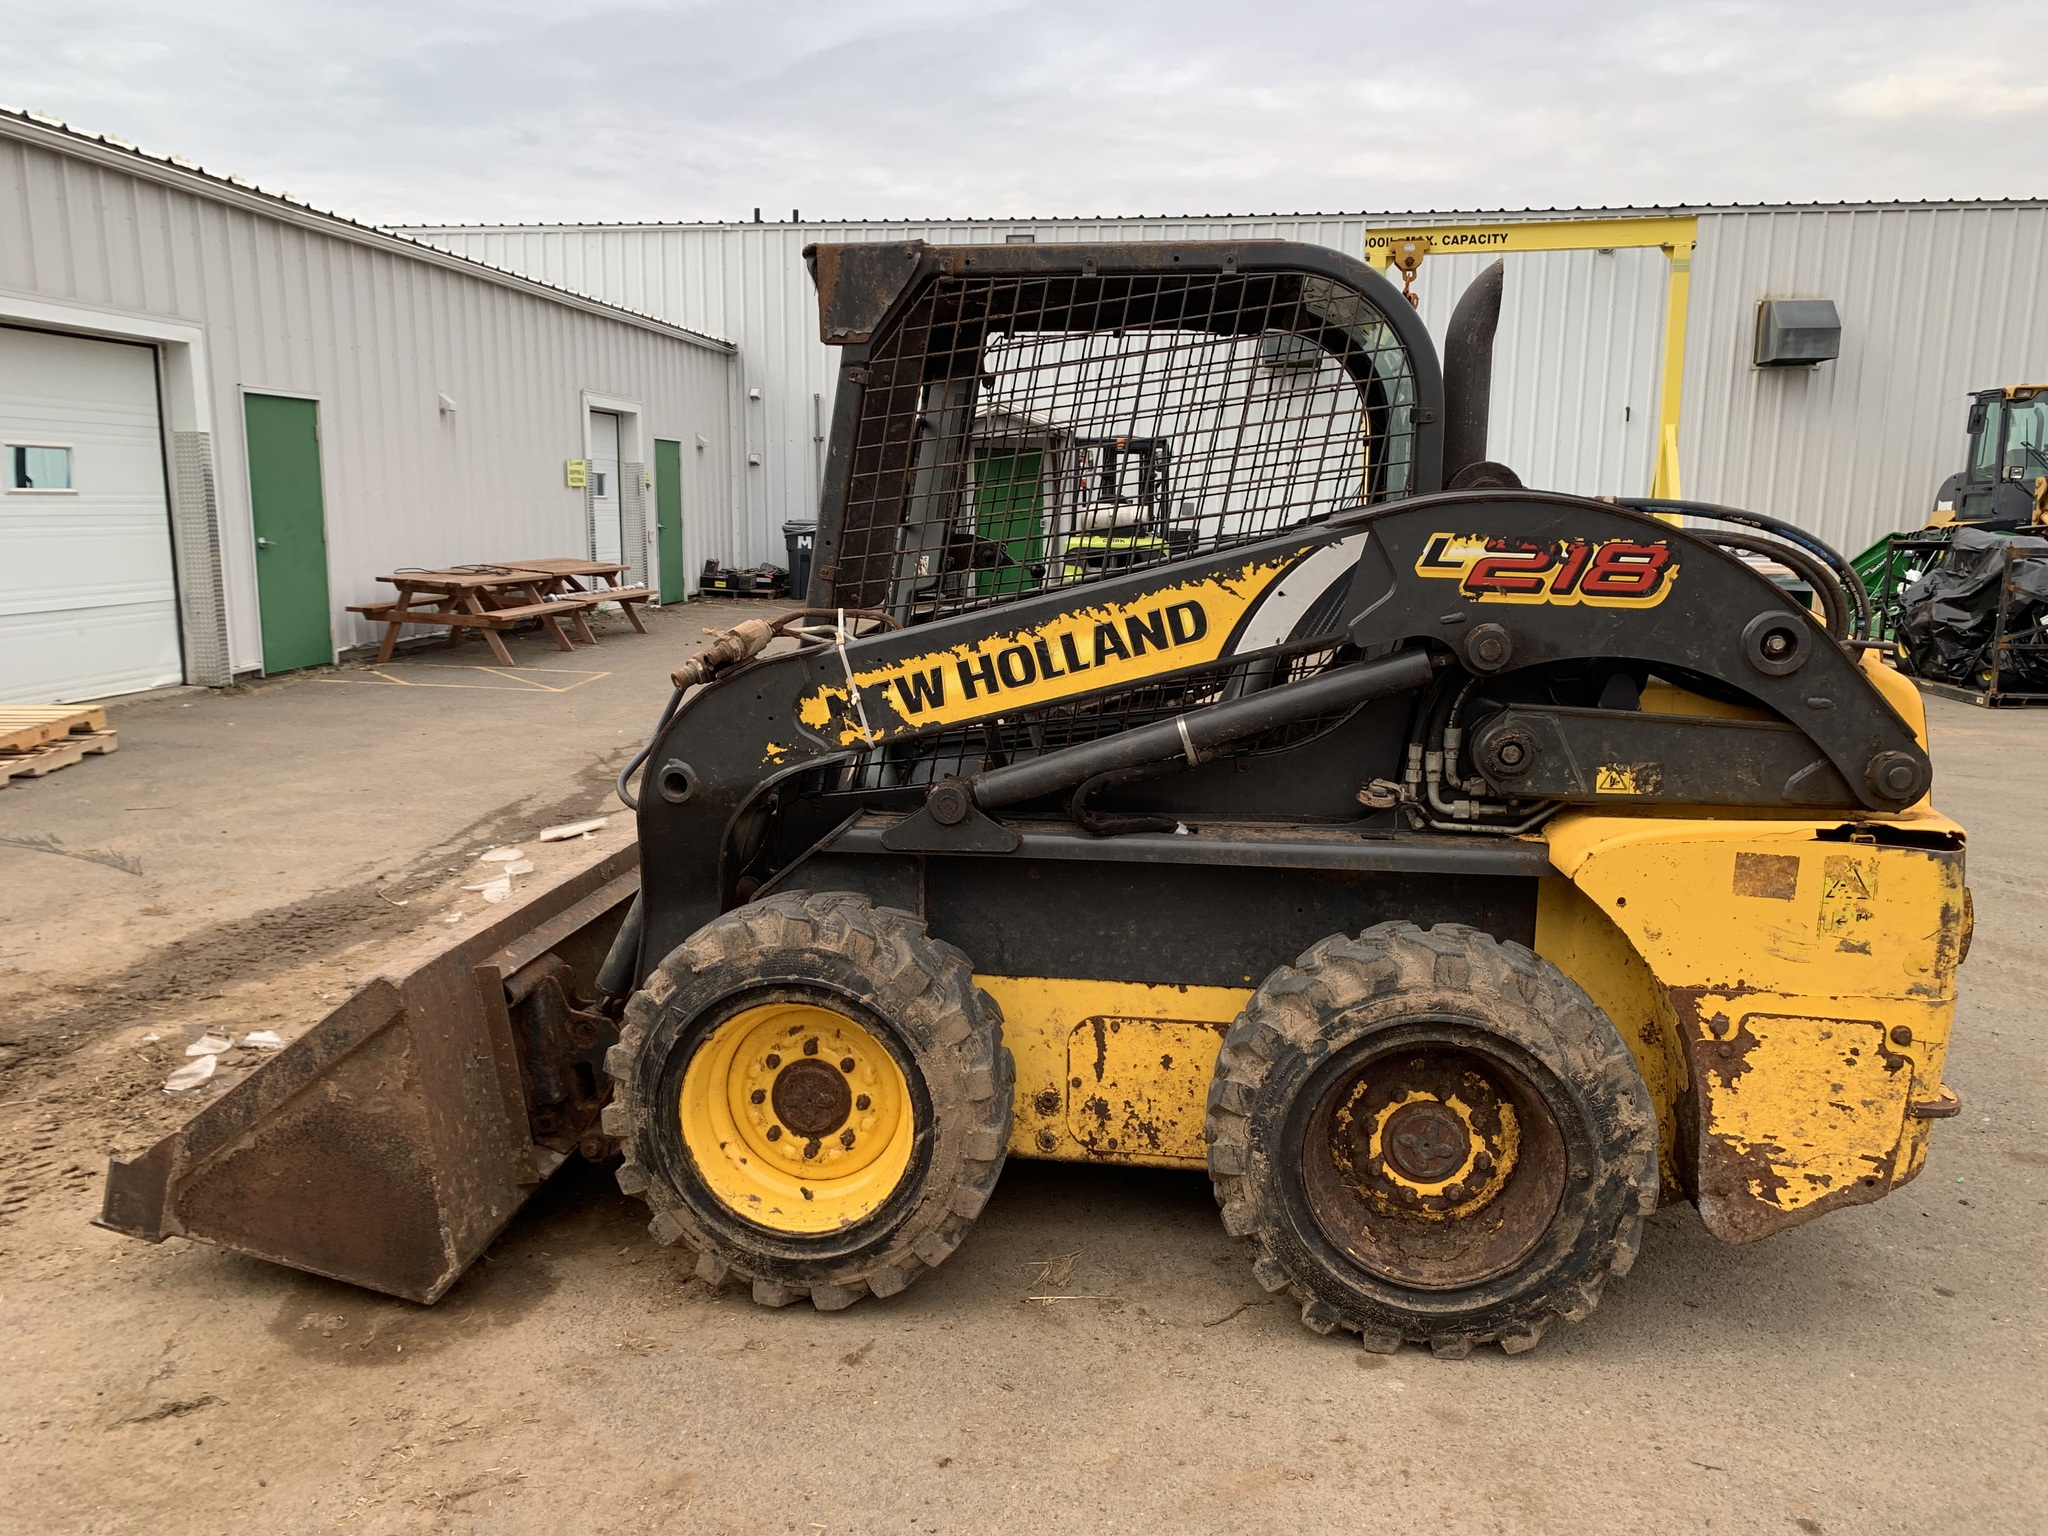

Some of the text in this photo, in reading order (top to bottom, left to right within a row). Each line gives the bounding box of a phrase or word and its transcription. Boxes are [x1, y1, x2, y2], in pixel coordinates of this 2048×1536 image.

[1442, 232, 1509, 246] CAPACITY
[797, 535, 813, 550] M
[957, 599, 1208, 701] HOLLAND
